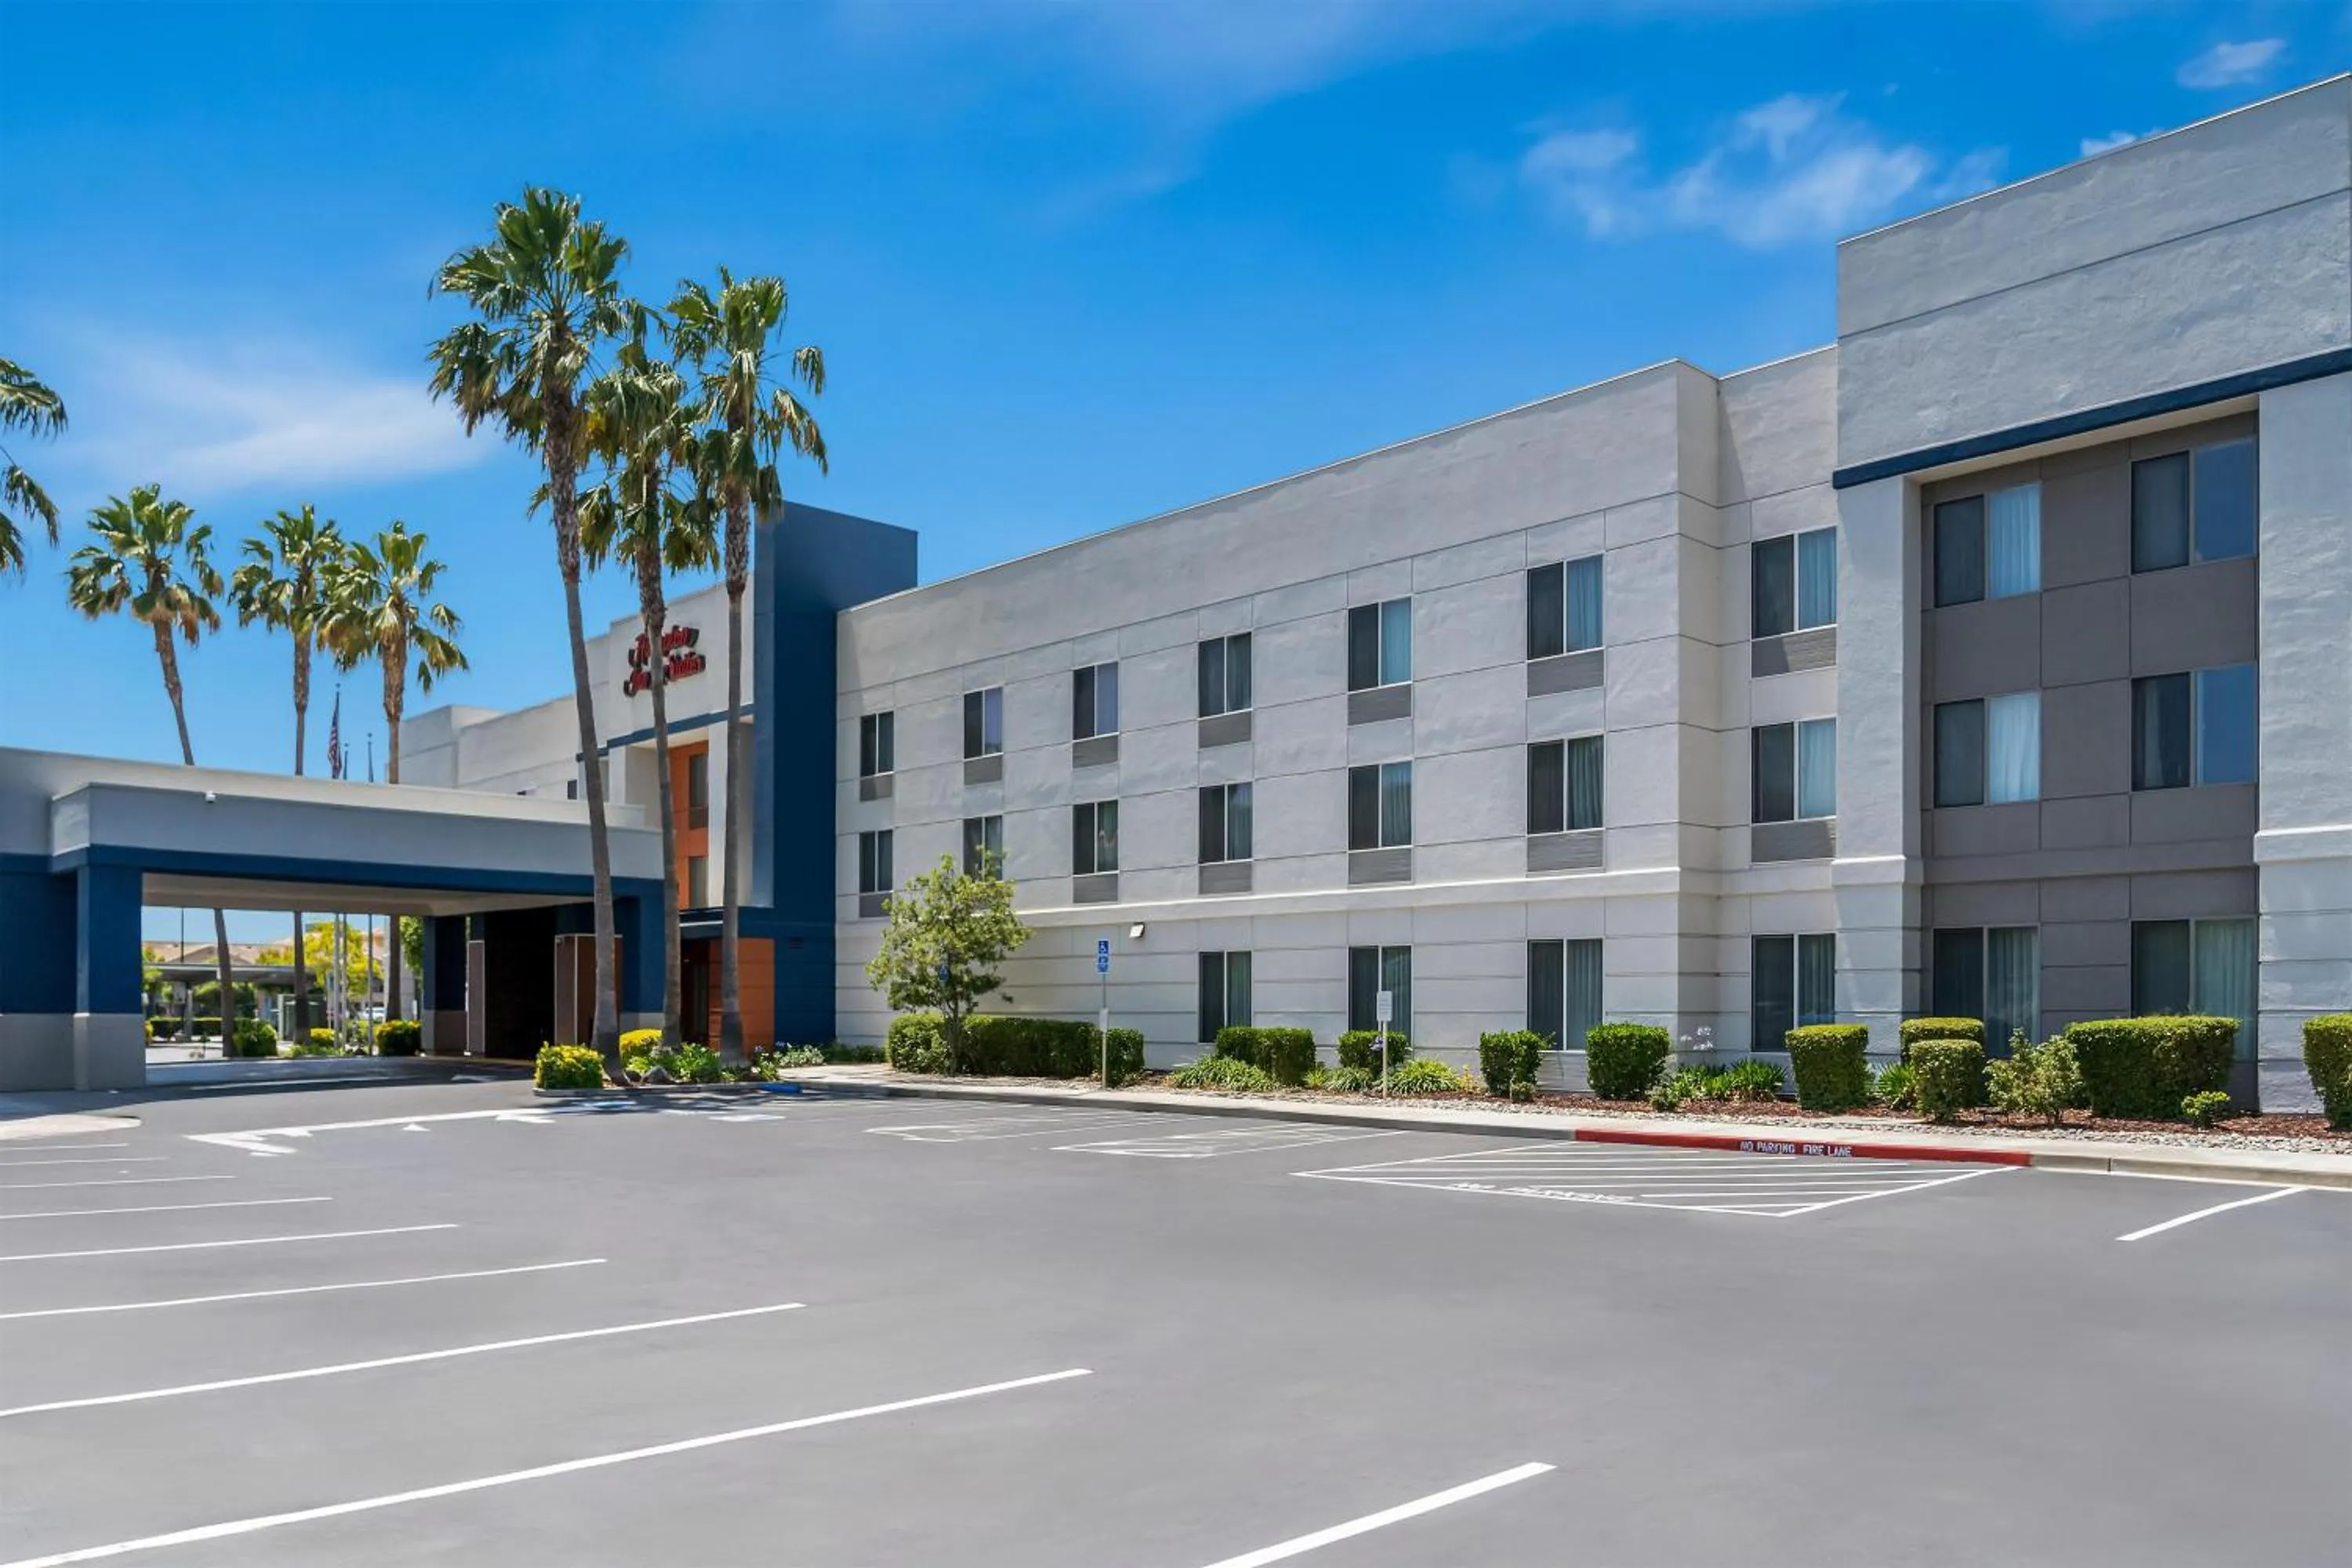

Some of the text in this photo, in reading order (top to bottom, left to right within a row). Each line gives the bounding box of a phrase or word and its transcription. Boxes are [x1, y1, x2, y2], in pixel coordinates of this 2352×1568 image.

[1740, 1141, 1754, 1152] NO
[1802, 1144, 1824, 1155] FIRE
[1828, 1145, 1853, 1157] LANE
